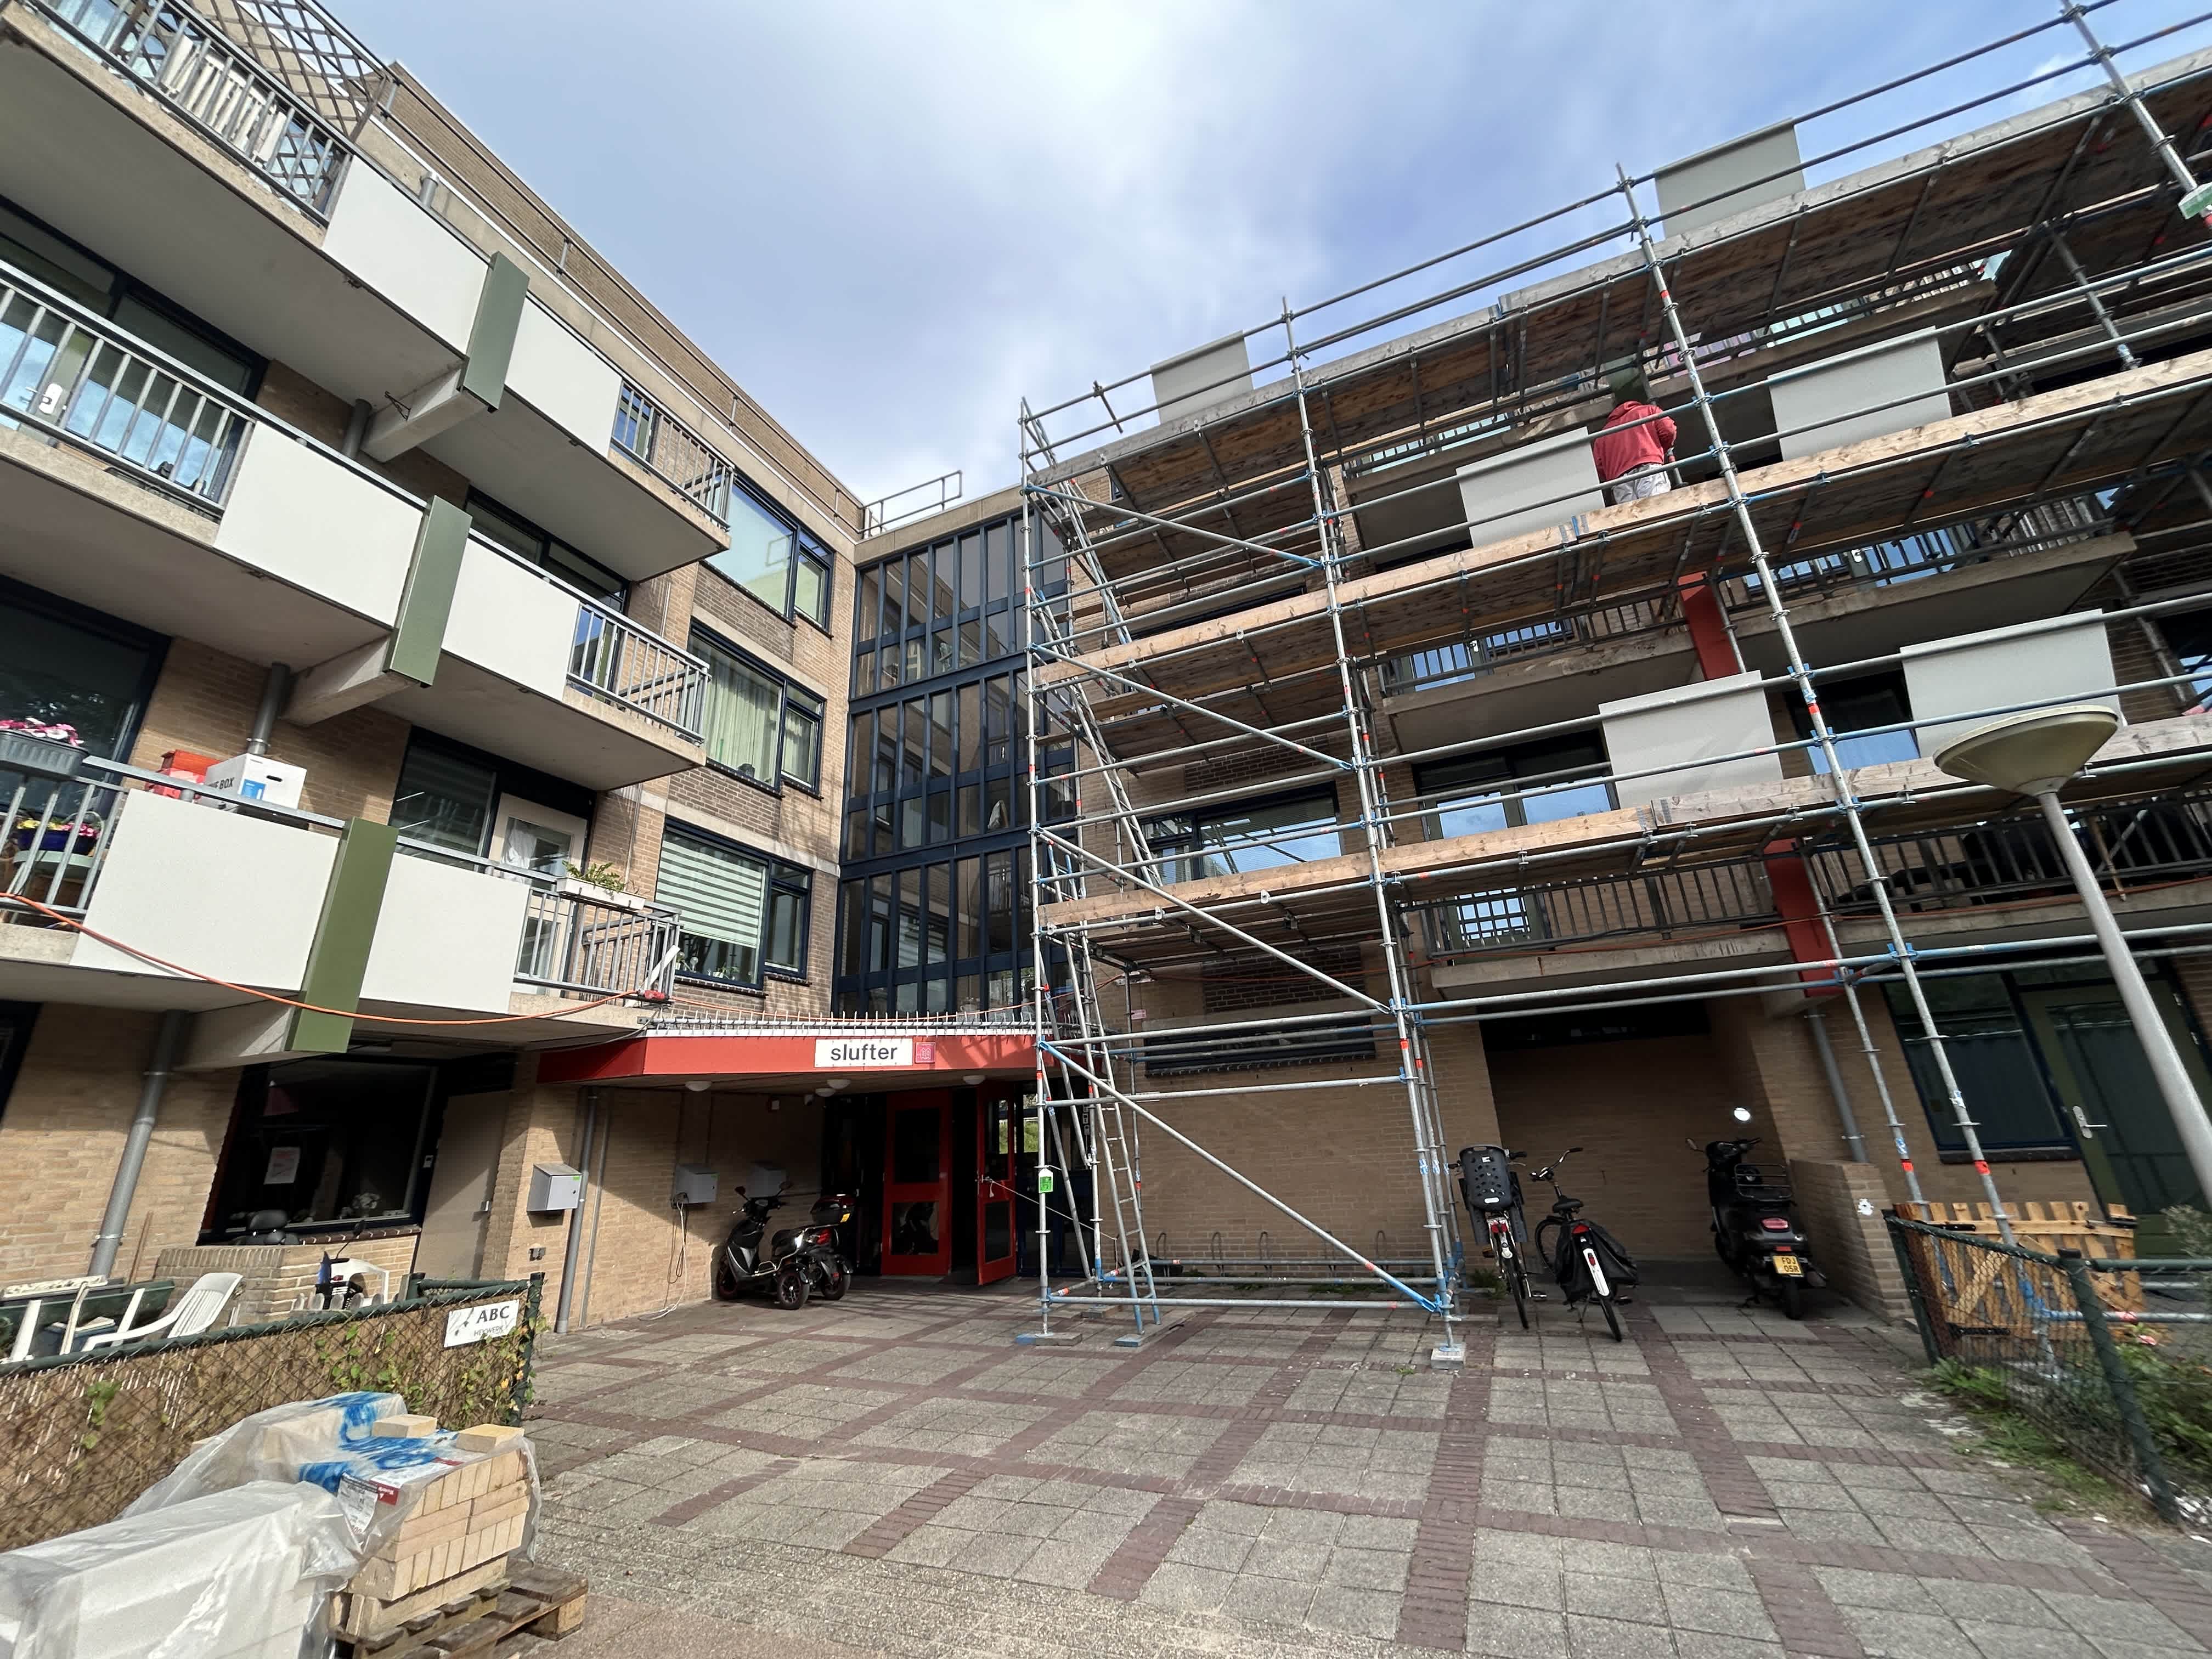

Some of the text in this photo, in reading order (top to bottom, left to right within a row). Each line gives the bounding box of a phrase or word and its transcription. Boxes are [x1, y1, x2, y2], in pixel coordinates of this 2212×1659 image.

[219, 777, 235, 789] BOX
[831, 1043, 898, 1060] slufter
[476, 1306, 510, 1324] ABC
